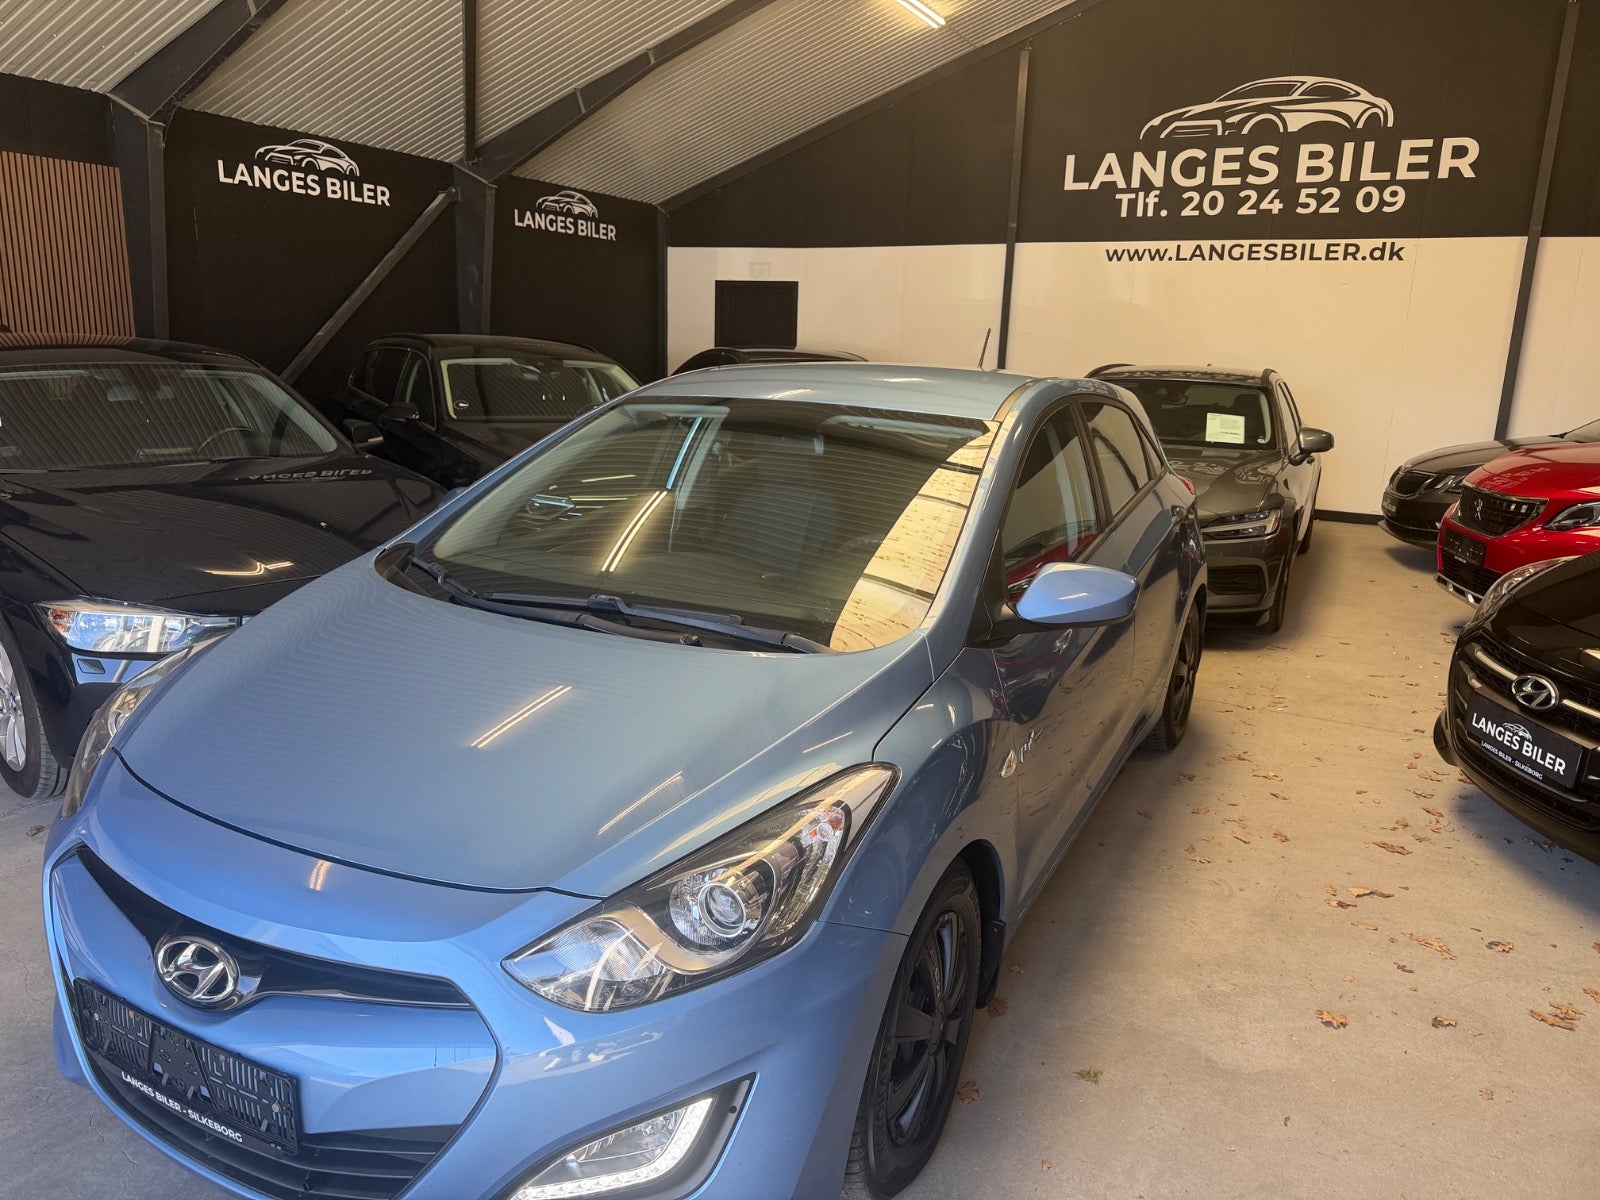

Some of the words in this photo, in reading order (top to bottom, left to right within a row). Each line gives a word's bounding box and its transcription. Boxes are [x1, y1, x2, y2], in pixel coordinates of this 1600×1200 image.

[217, 160, 321, 195] LANGES
[326, 177, 390, 206] BILER
[1063, 145, 1281, 190] LANGES
[1295, 137, 1481, 183] BILER
[1115, 193, 1168, 218] Tlf.
[1180, 191, 1225, 216] 20
[1236, 189, 1284, 215] 24
[1296, 187, 1341, 213] 52
[1354, 185, 1406, 213] 09
[514, 209, 574, 234] LANGES
[578, 220, 616, 240] BILER
[1105, 241, 1405, 262] www.LANGESBILER.dk
[1472, 713, 1520, 750] LANGES
[1522, 741, 1566, 775] BILER
[1481, 741, 1499, 755] LANGES
[1498, 750, 1512, 763] BILER
[1514, 760, 1543, 779] SILKEBORG
[121, 1071, 154, 1097] LANGES
[156, 1092, 182, 1113] BILER
[188, 1109, 243, 1143] SILKEBORG
